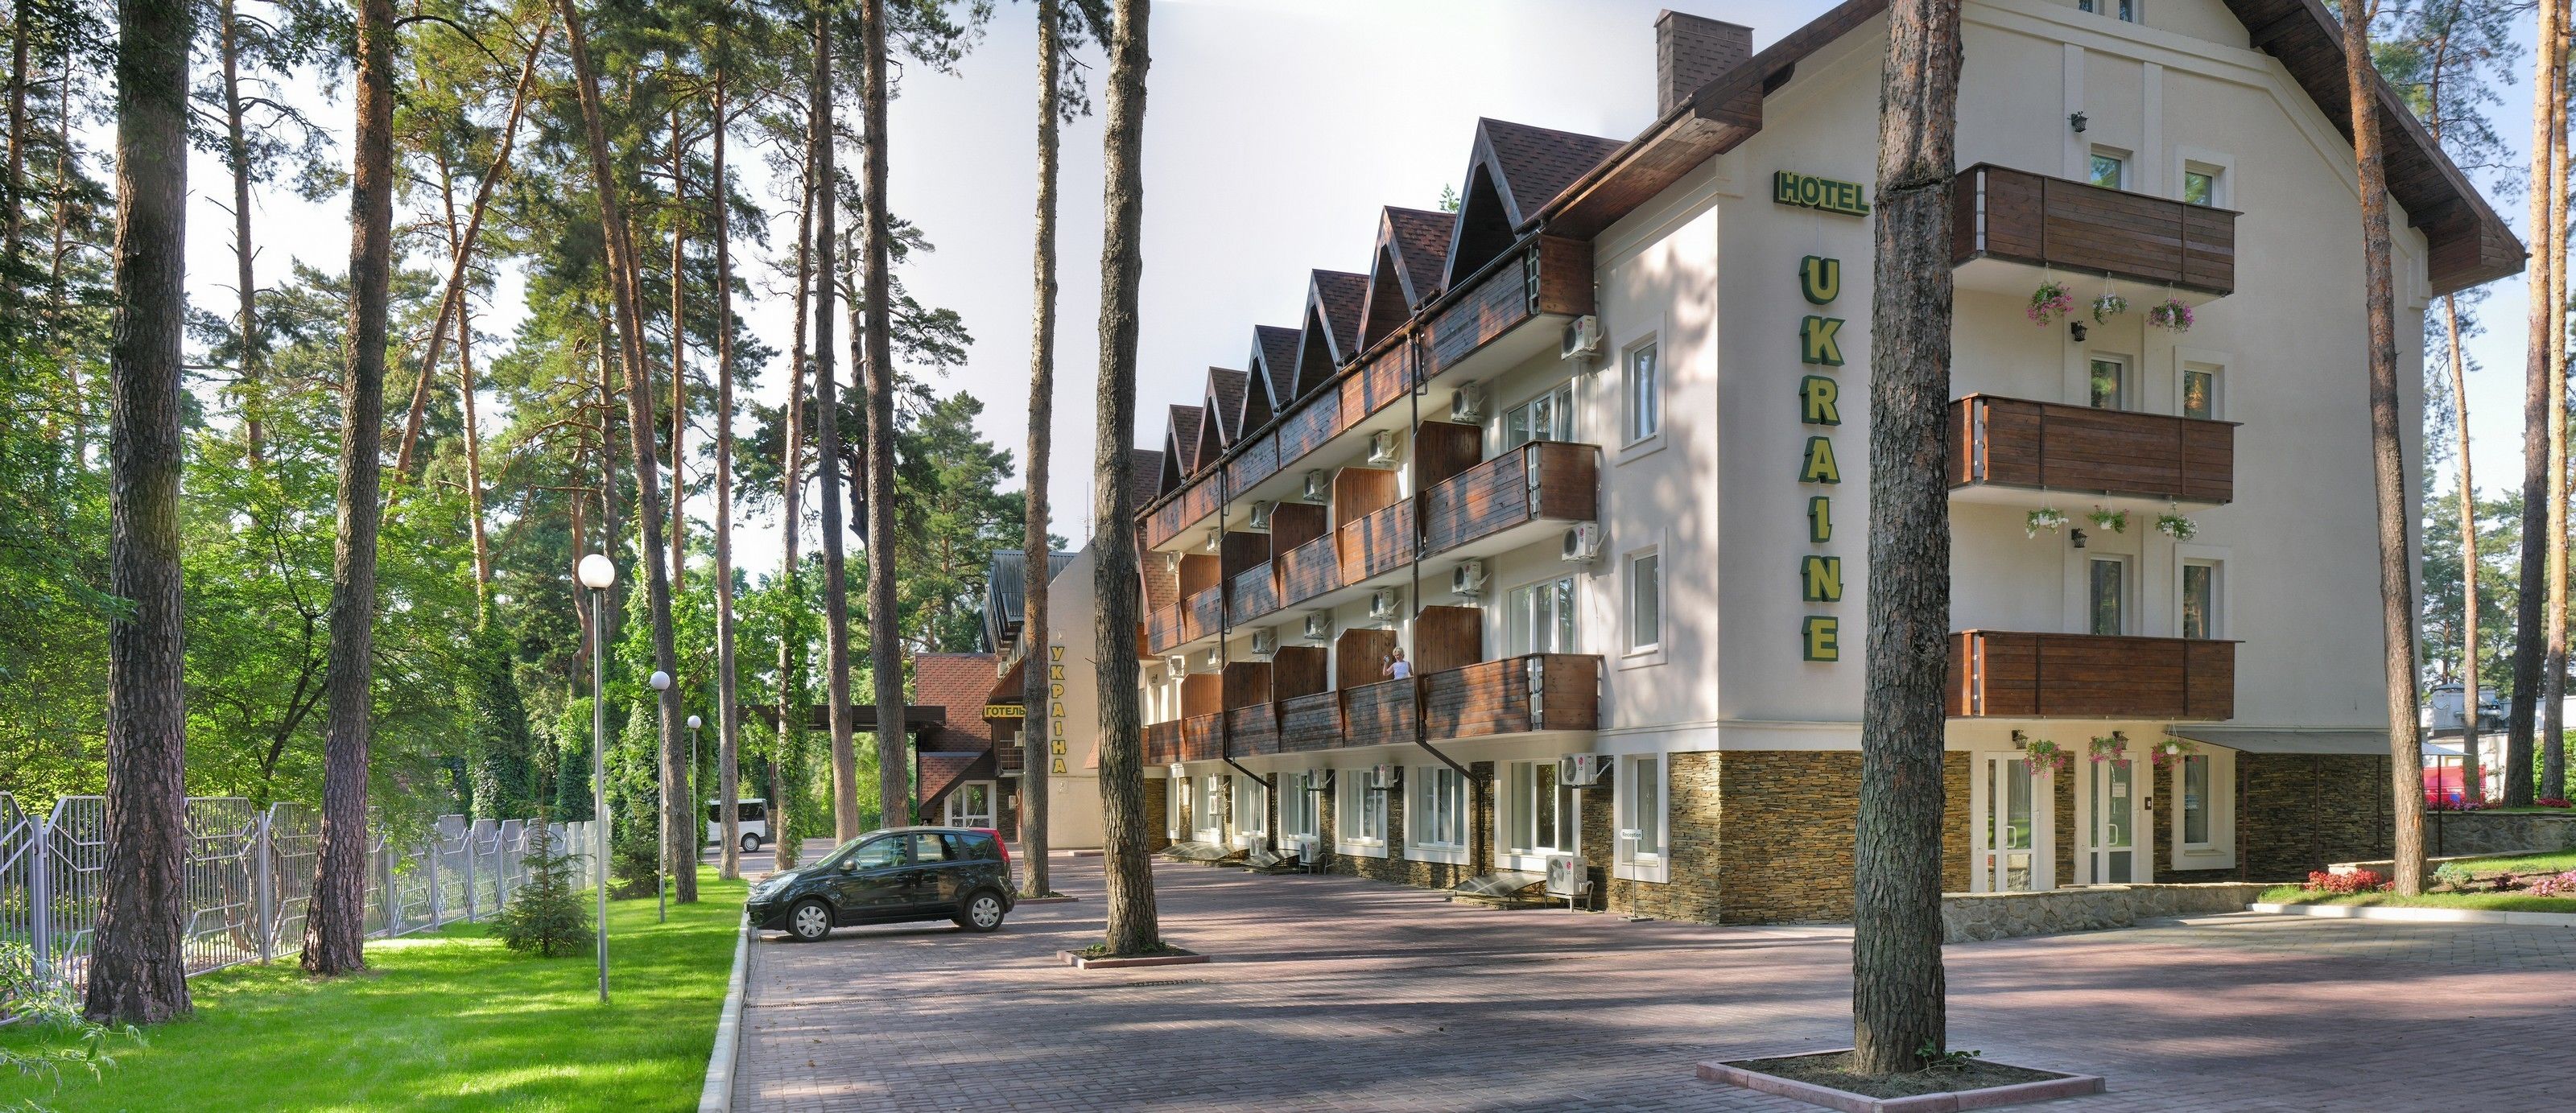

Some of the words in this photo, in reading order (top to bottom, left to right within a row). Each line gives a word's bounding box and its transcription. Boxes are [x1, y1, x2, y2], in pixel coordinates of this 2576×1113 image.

[1774, 170, 1870, 216] HOTEL
[1799, 255, 1845, 662] UKRAINE
[985, 706, 1026, 716] ГОТЕЛЬ
